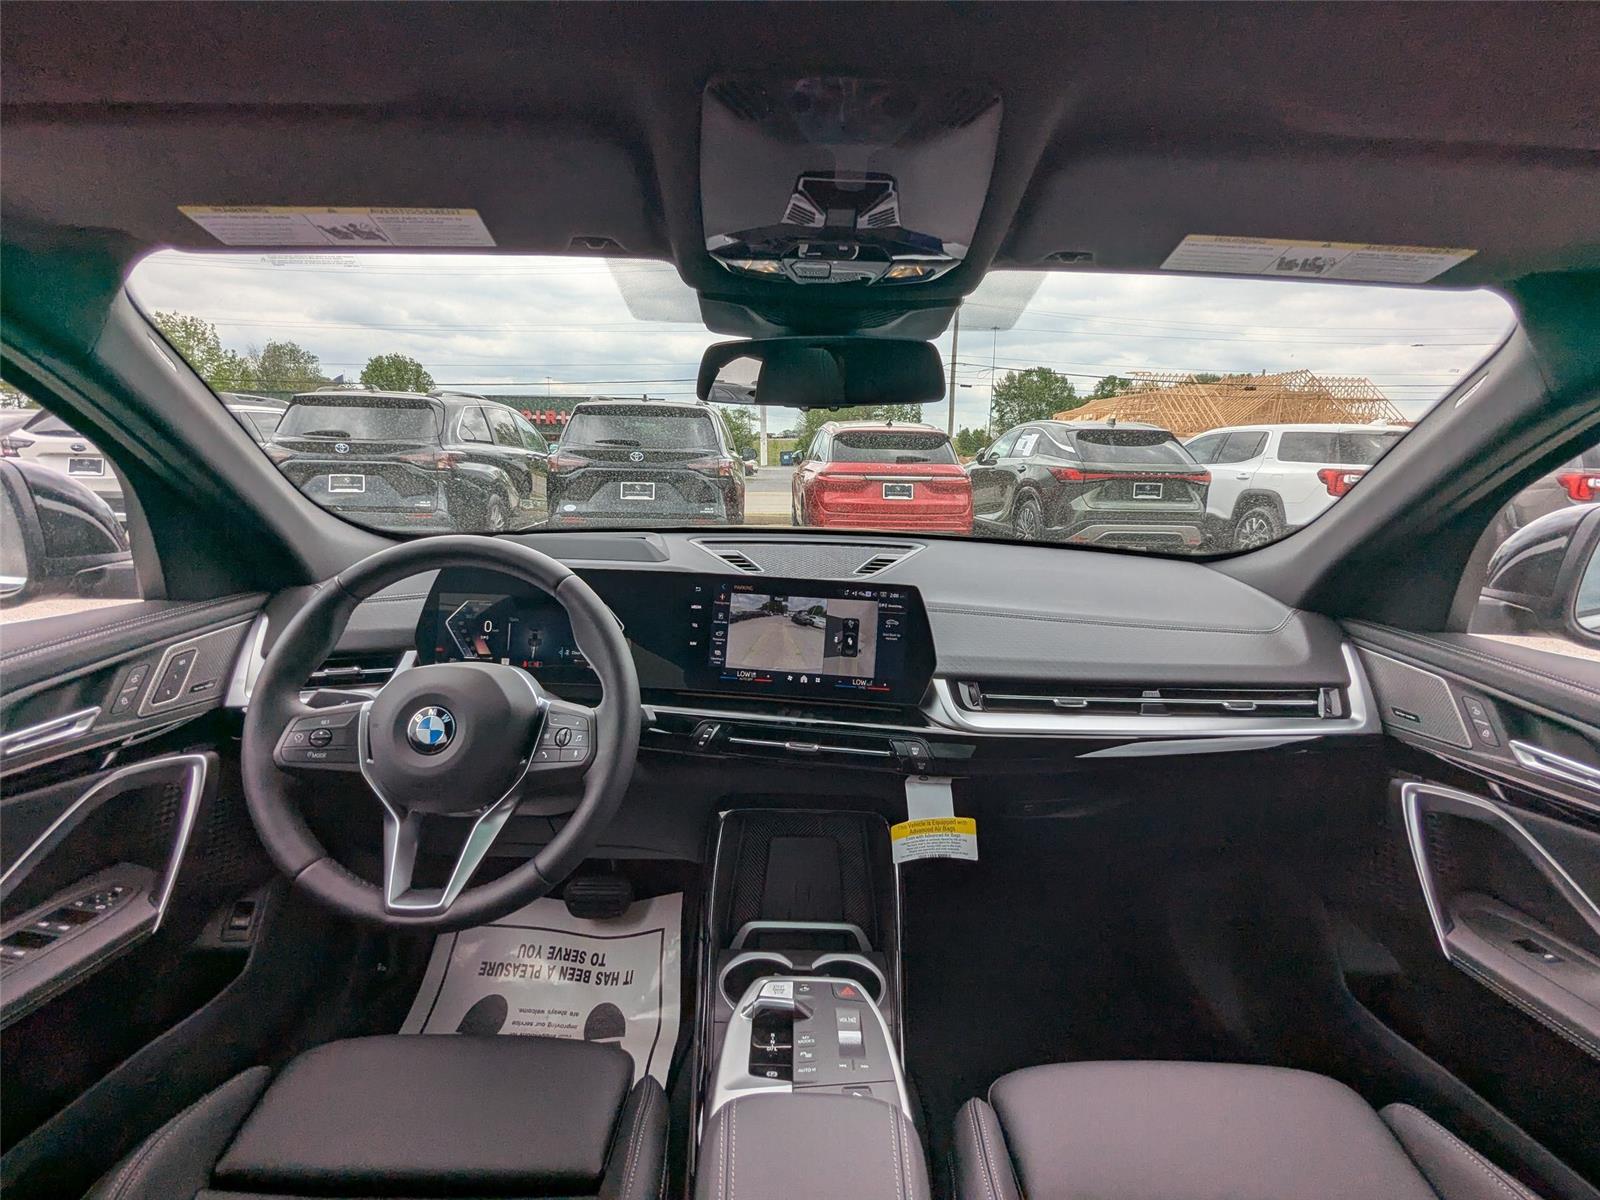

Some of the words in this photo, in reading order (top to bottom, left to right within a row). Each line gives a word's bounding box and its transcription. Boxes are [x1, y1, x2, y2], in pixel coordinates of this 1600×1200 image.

[852, 678, 867, 686] LOW
[414, 708, 451, 723] BMW
[516, 943, 543, 960] YOU
[547, 945, 588, 965] SERVE
[590, 952, 607, 967] TO
[478, 961, 543, 980] PLEASURE
[547, 965, 557, 979] A
[558, 966, 592, 984] BEEN
[595, 970, 621, 986] HAS
[622, 969, 635, 985] IT
